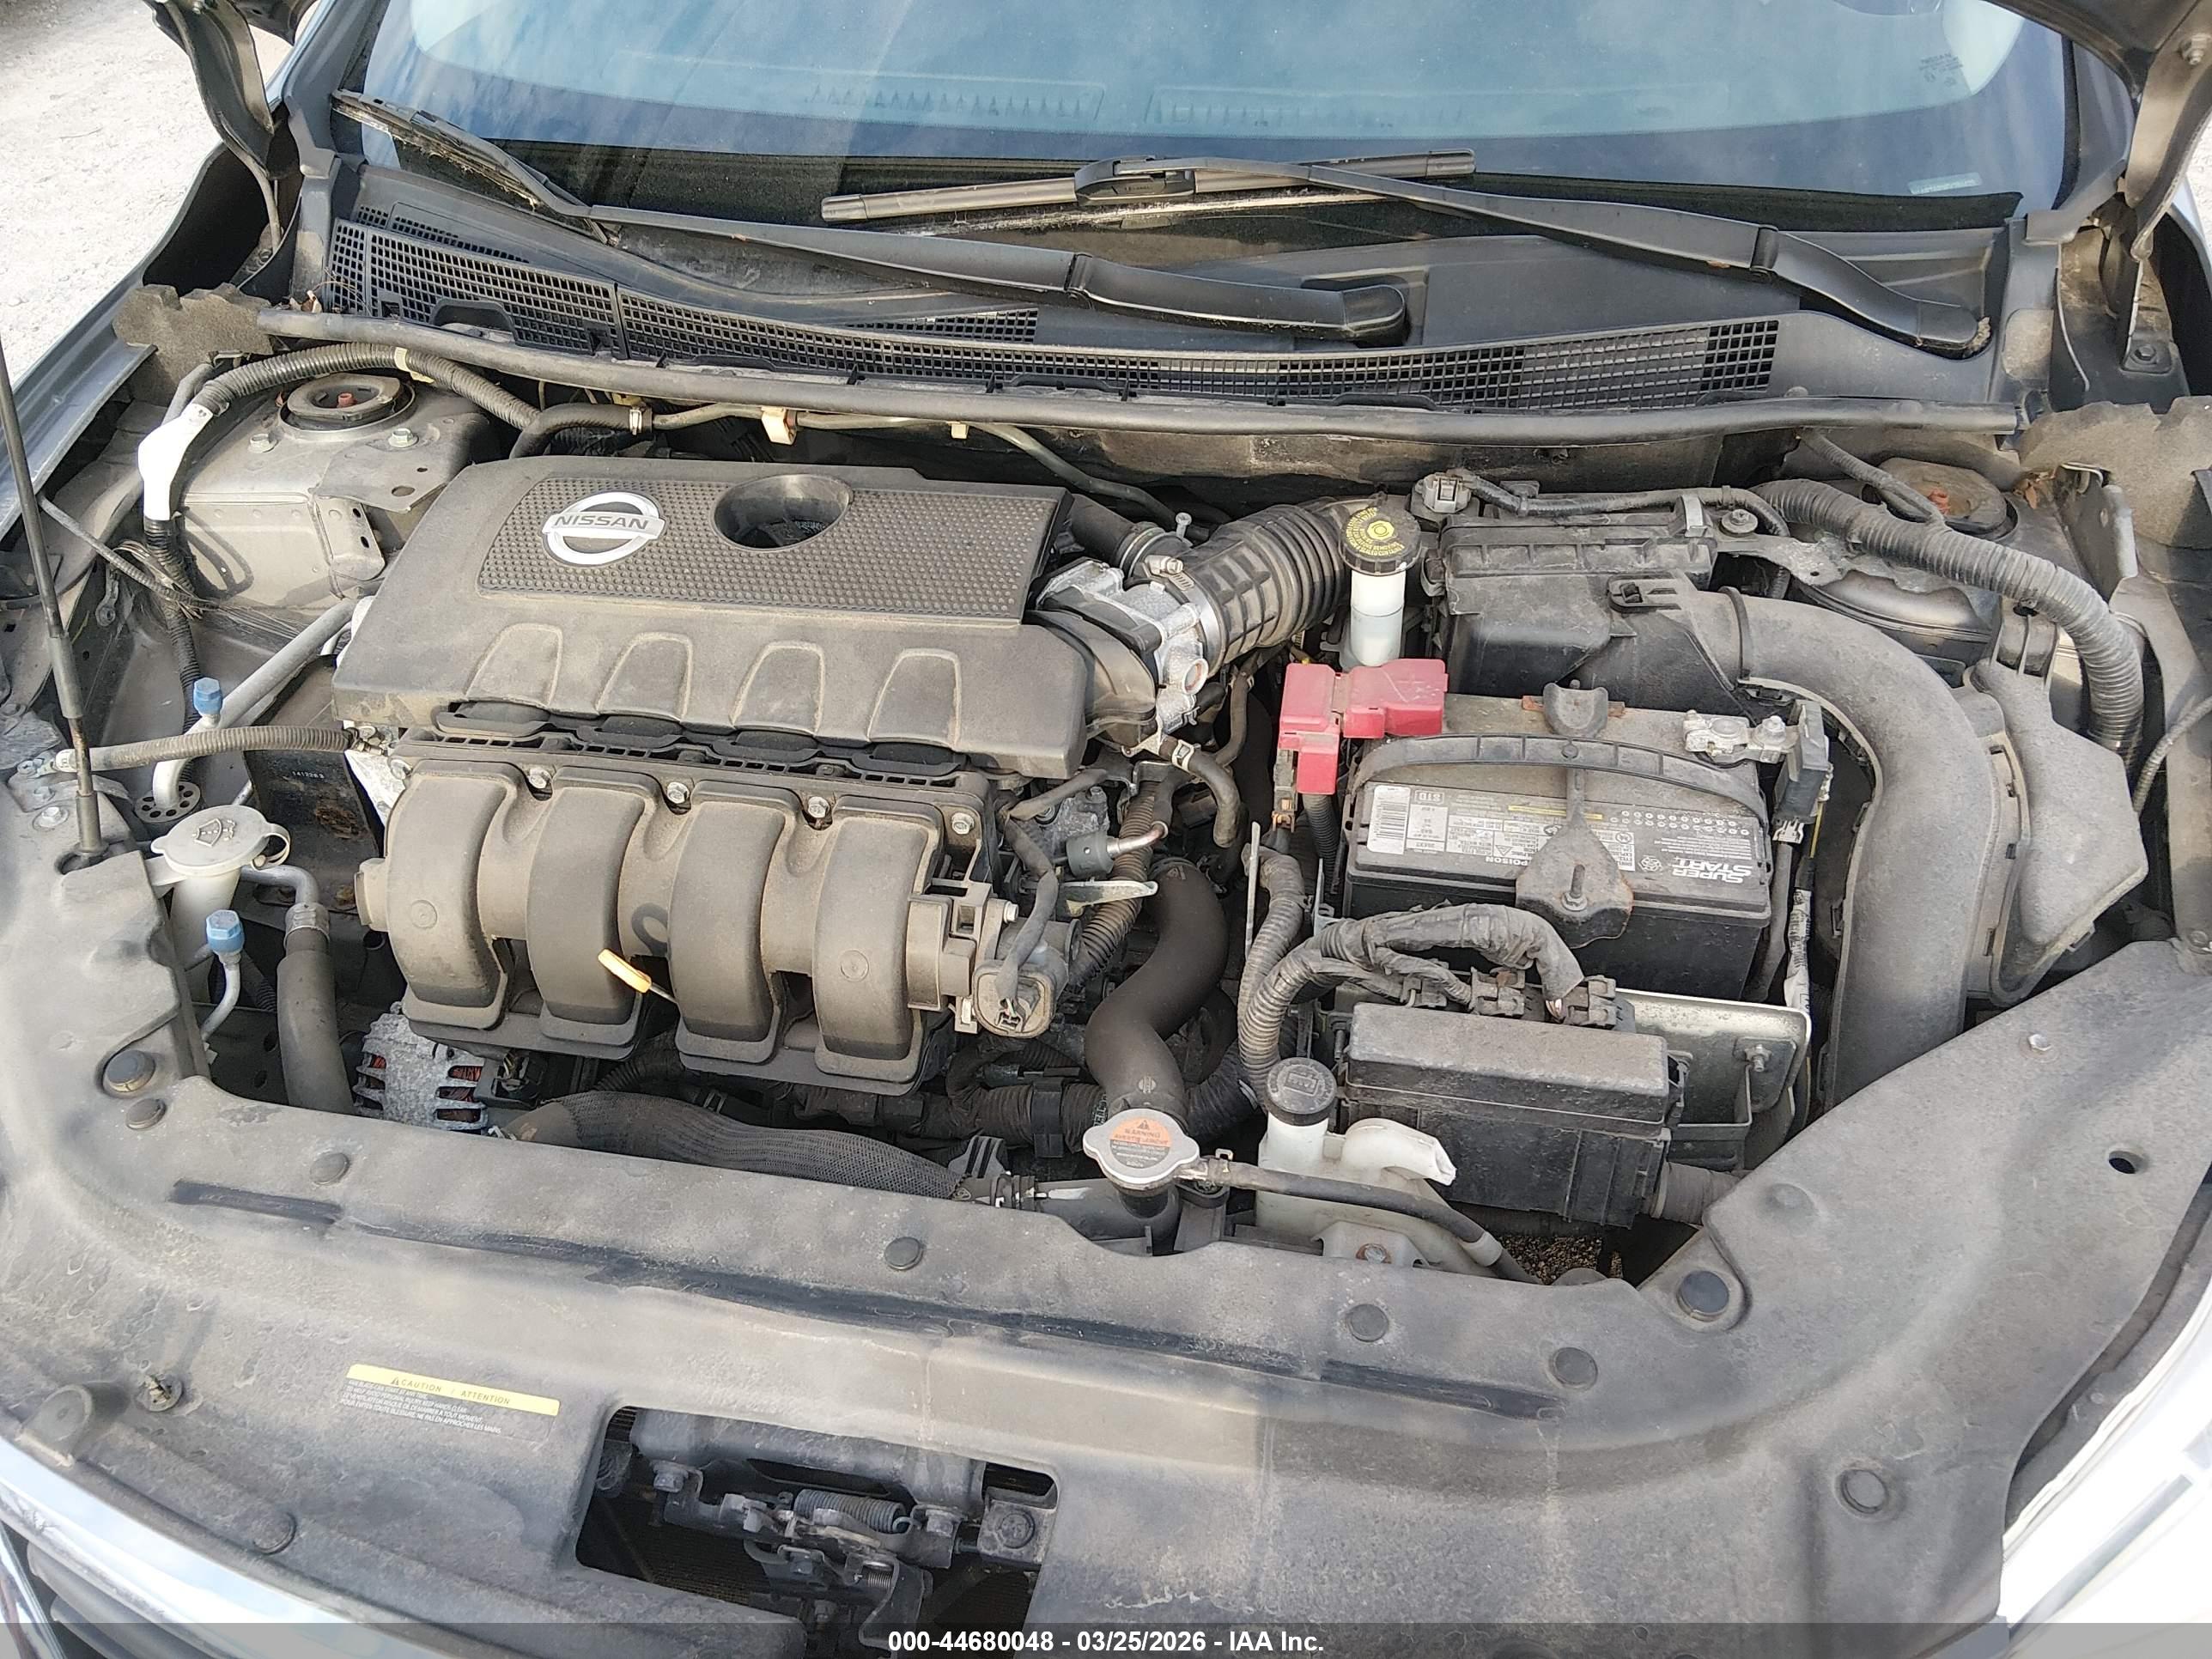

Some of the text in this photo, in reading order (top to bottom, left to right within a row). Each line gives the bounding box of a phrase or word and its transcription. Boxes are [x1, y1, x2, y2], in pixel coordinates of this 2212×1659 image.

[555, 516, 648, 530] NISSAN
[1485, 855, 1528, 866] POISON
[1672, 859, 1753, 877] START
[1672, 867, 1744, 884] SUPER
[1124, 1128, 1160, 1138] WARNING
[401, 1380, 442, 1394] CAUTION
[460, 1389, 511, 1406] ATTENTION
